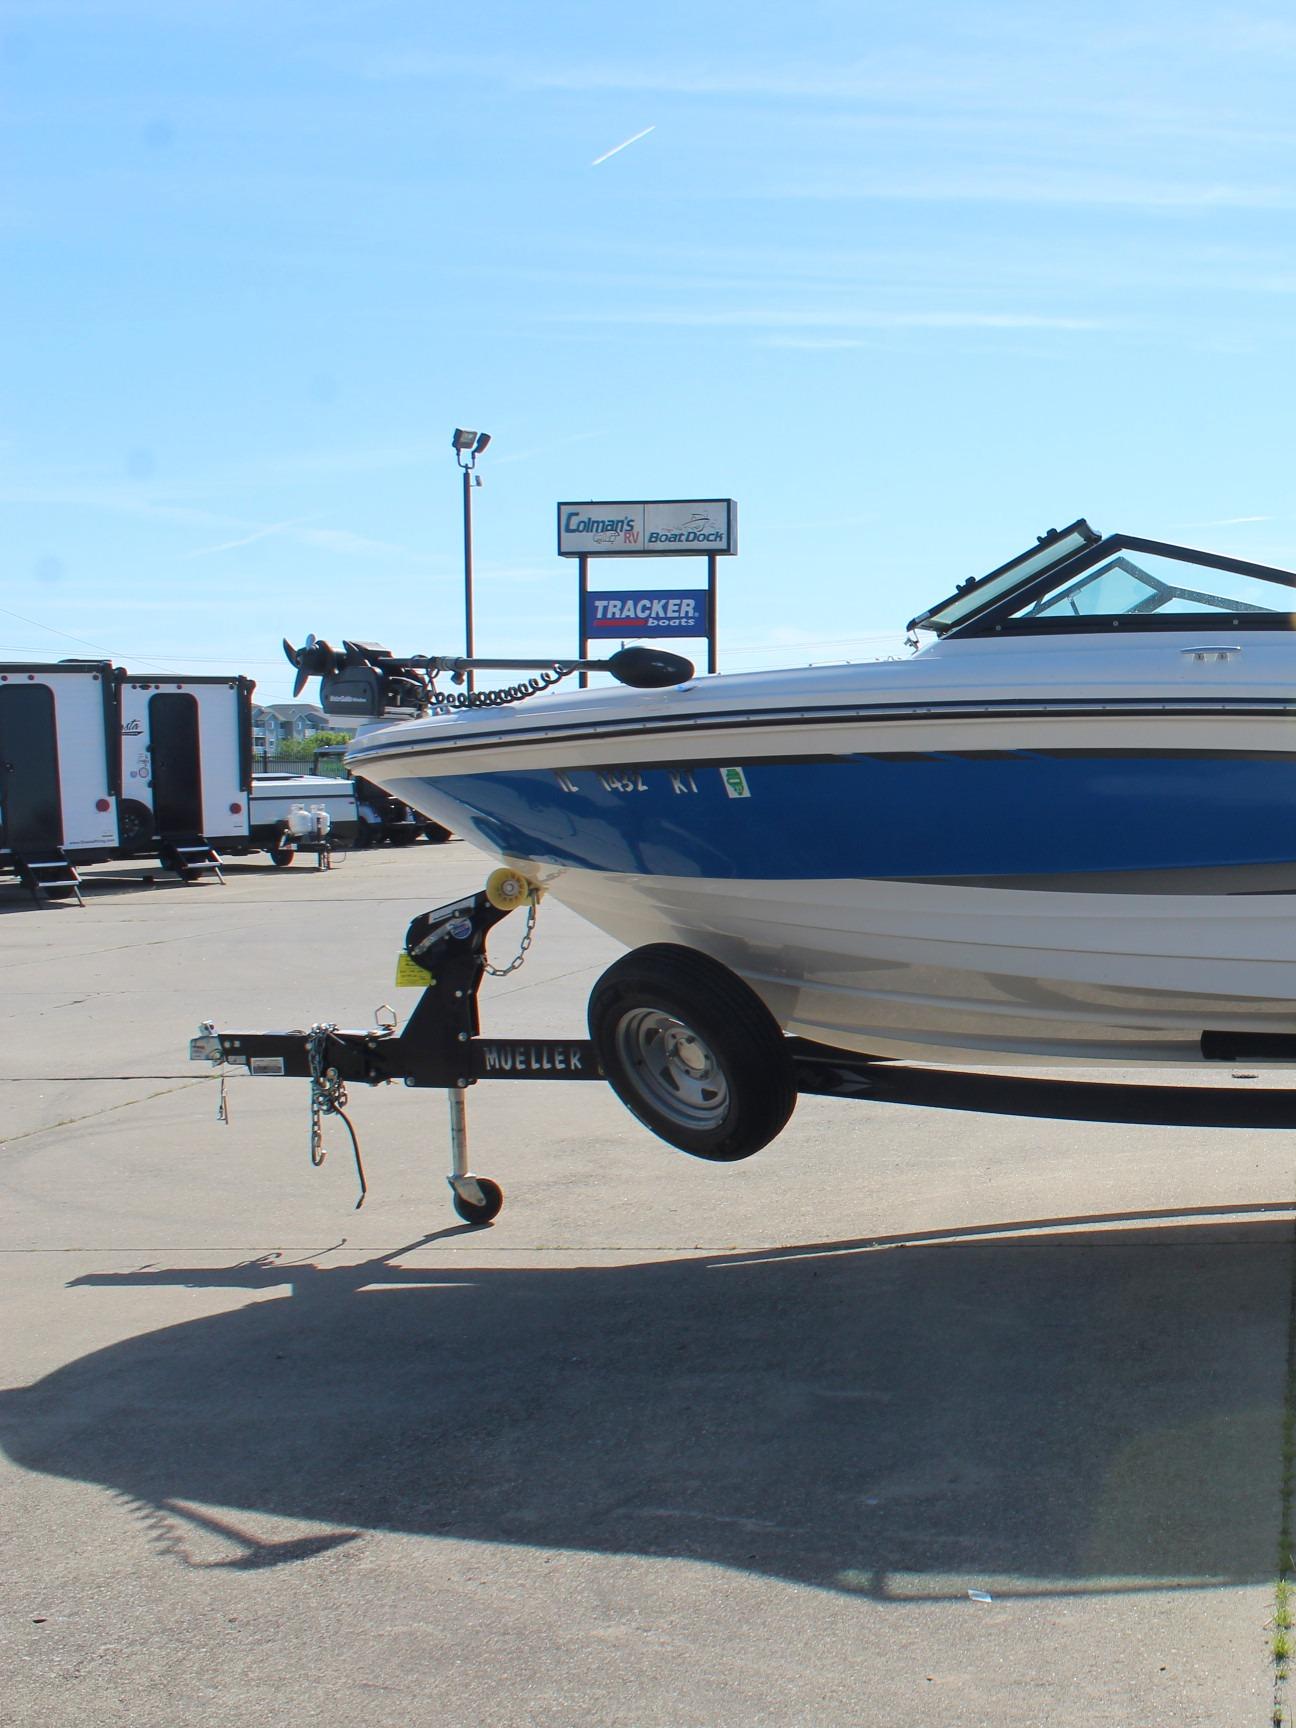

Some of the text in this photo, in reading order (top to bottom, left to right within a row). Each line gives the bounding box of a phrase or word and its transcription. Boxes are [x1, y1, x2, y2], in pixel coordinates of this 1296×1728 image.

[564, 512, 635, 533] Colman's
[623, 531, 640, 544] RV
[594, 600, 696, 619] TRACKER
[648, 618, 696, 626] boats
[483, 1046, 583, 1071] MUELLER
